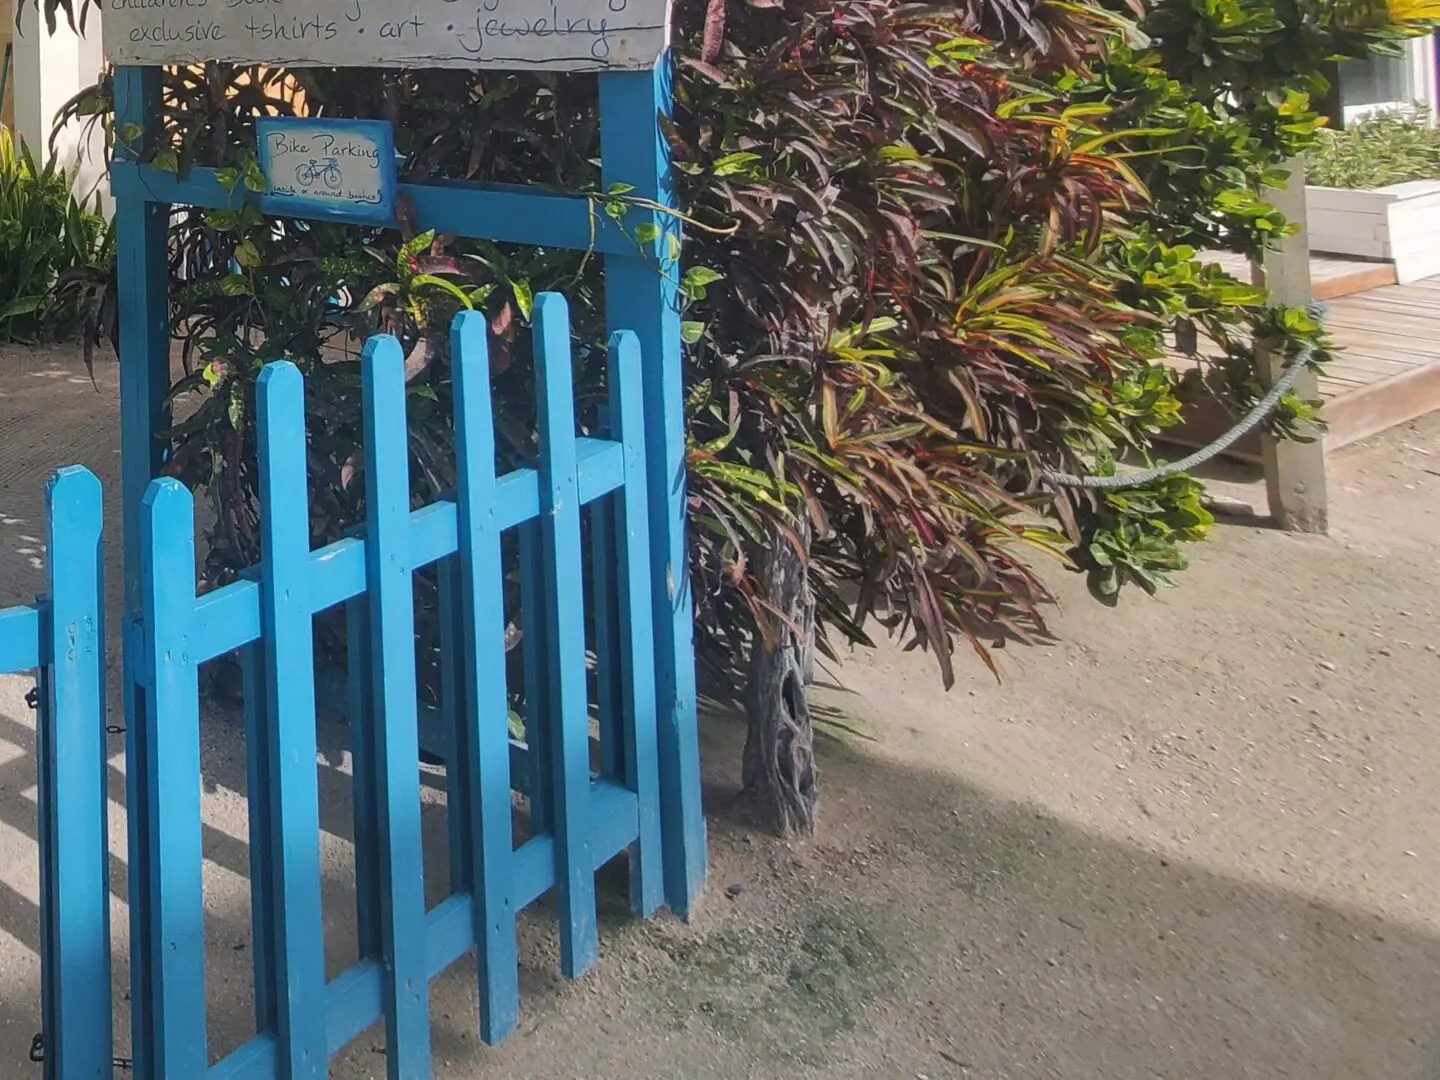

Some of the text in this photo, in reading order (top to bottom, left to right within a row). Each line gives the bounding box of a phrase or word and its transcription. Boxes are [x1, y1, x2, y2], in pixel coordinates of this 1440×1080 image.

[129, 18, 228, 43] exclusive
[378, 14, 425, 39] art
[458, 5, 616, 58] jewelry
[265, 132, 380, 169] Bike Parking
